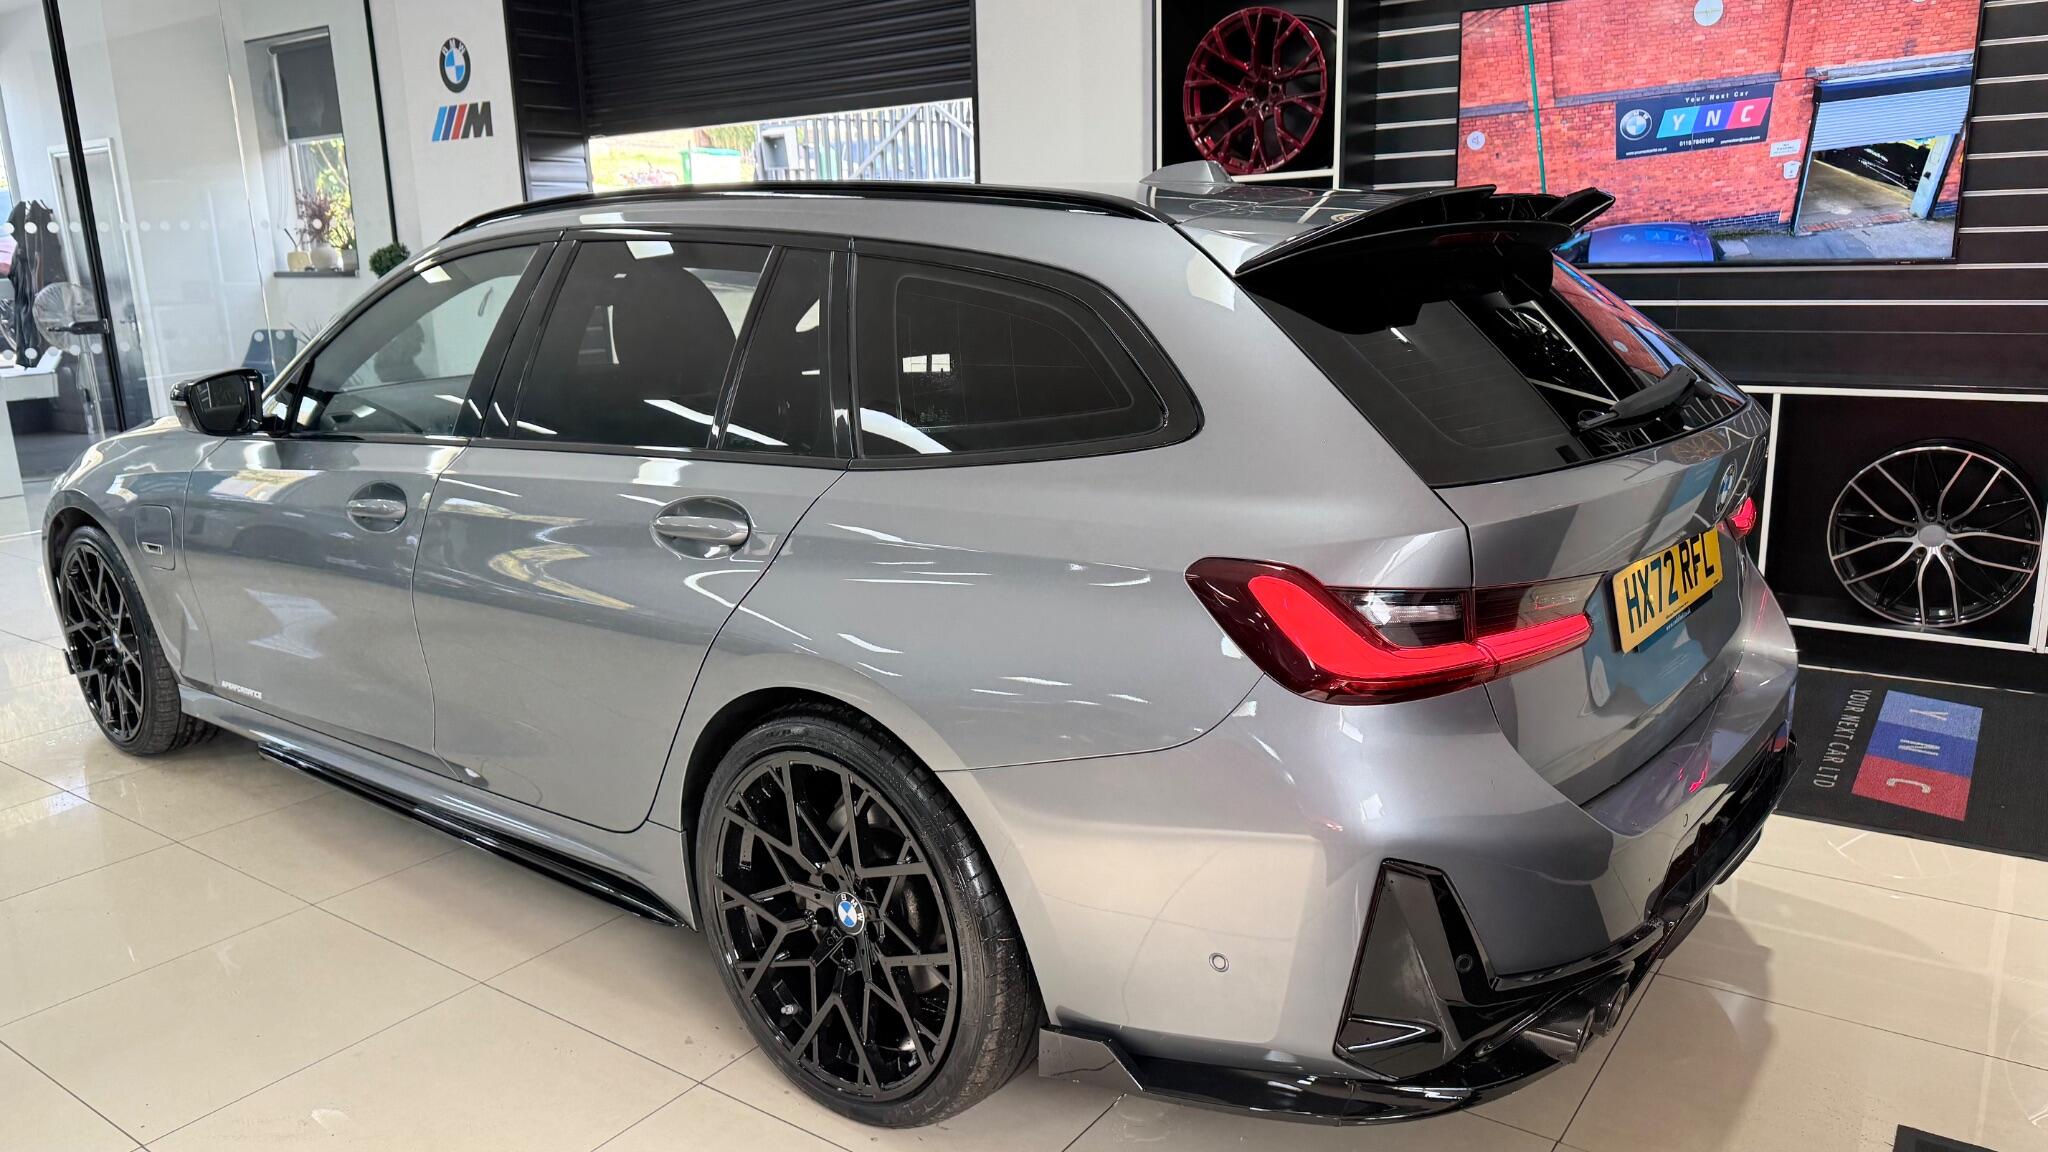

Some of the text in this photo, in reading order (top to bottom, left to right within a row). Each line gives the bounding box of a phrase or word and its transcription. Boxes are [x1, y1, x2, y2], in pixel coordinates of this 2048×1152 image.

[441, 39, 466, 55] BMW
[1685, 96, 1705, 104] Your
[1734, 90, 1749, 98] Car
[1624, 531, 1715, 634] HX72 RFL
[1813, 688, 1872, 788] YOUR NEXT CAR LTD
